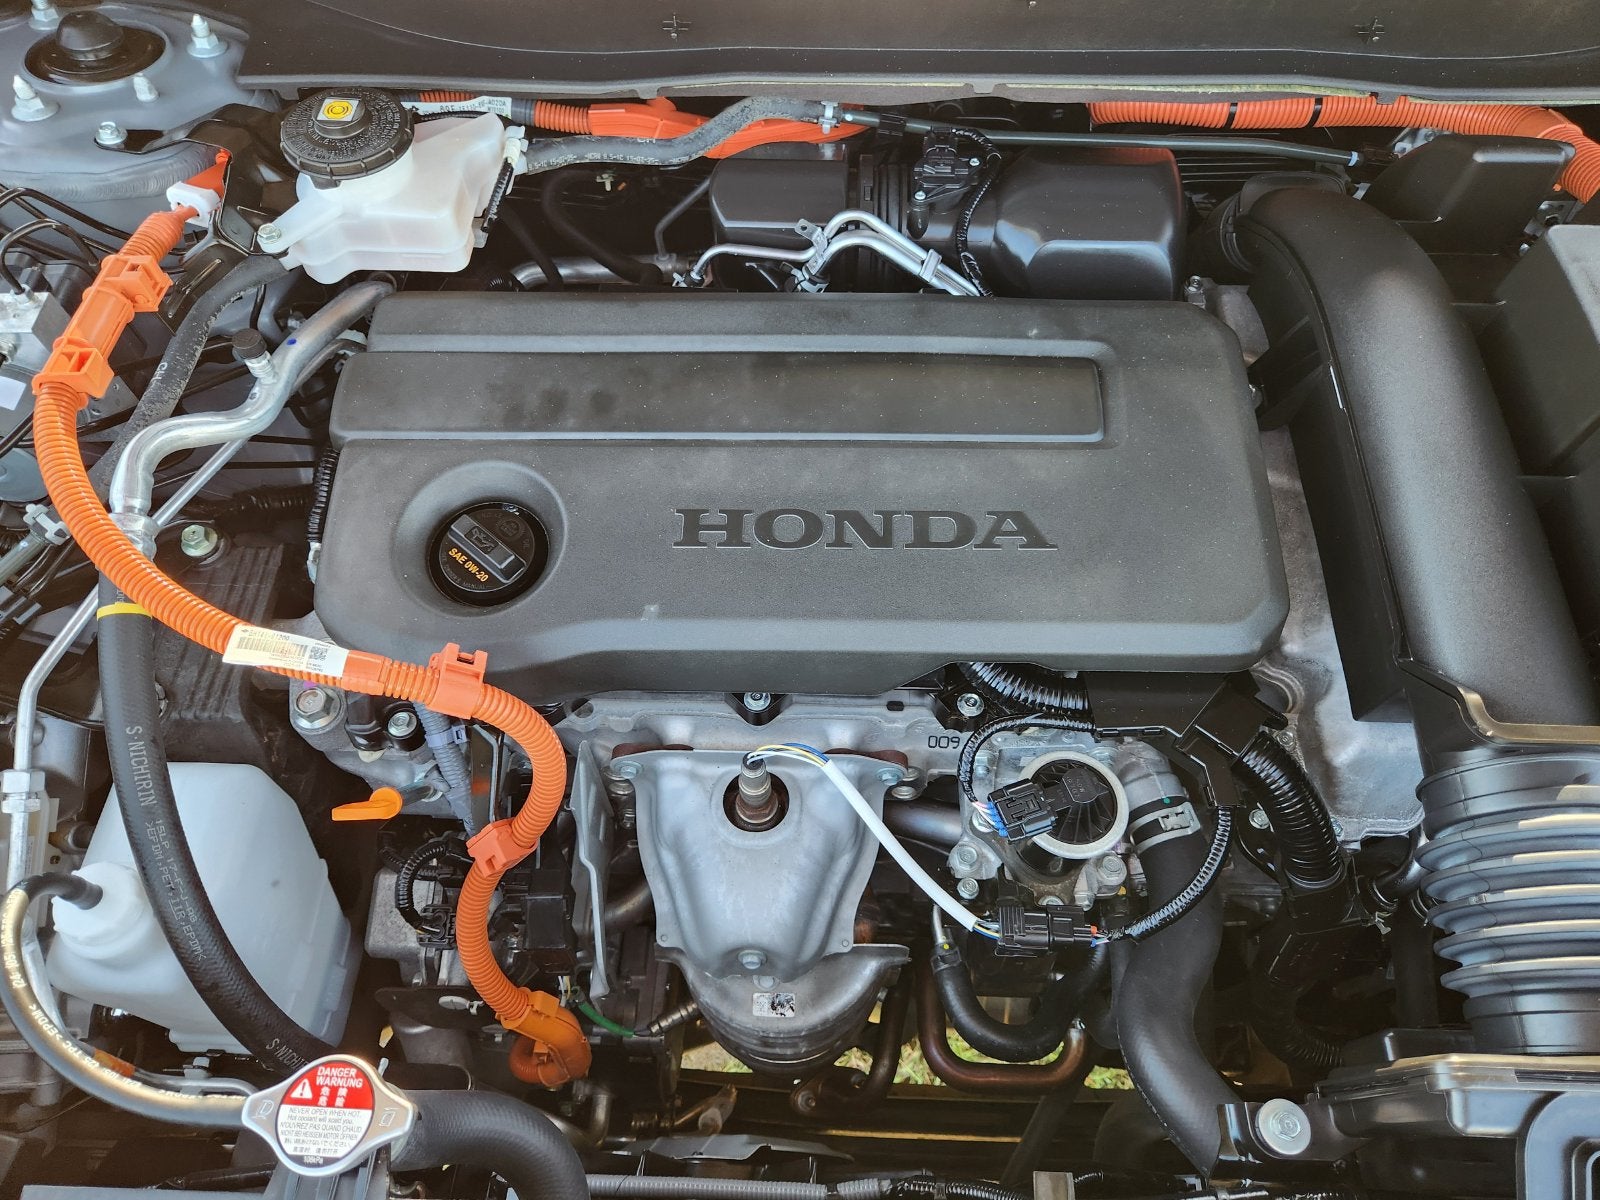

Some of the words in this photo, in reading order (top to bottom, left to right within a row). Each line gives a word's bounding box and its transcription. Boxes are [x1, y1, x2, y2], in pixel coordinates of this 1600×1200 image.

[672, 508, 1059, 550] HONDA
[448, 547, 468, 565] SAE
[464, 560, 489, 582] 0W-20
[62, 1039, 83, 1058] TPC
[317, 1066, 357, 1078] DANGER
[316, 1076, 363, 1088] WARNUNG
[287, 1113, 298, 1121] Hot
[289, 1107, 310, 1115] NEVER
[311, 1107, 328, 1115] OPEN
[329, 1109, 347, 1117] WHEN
[310, 1122, 321, 1131] PAS
[321, 1123, 341, 1132] QUAND
